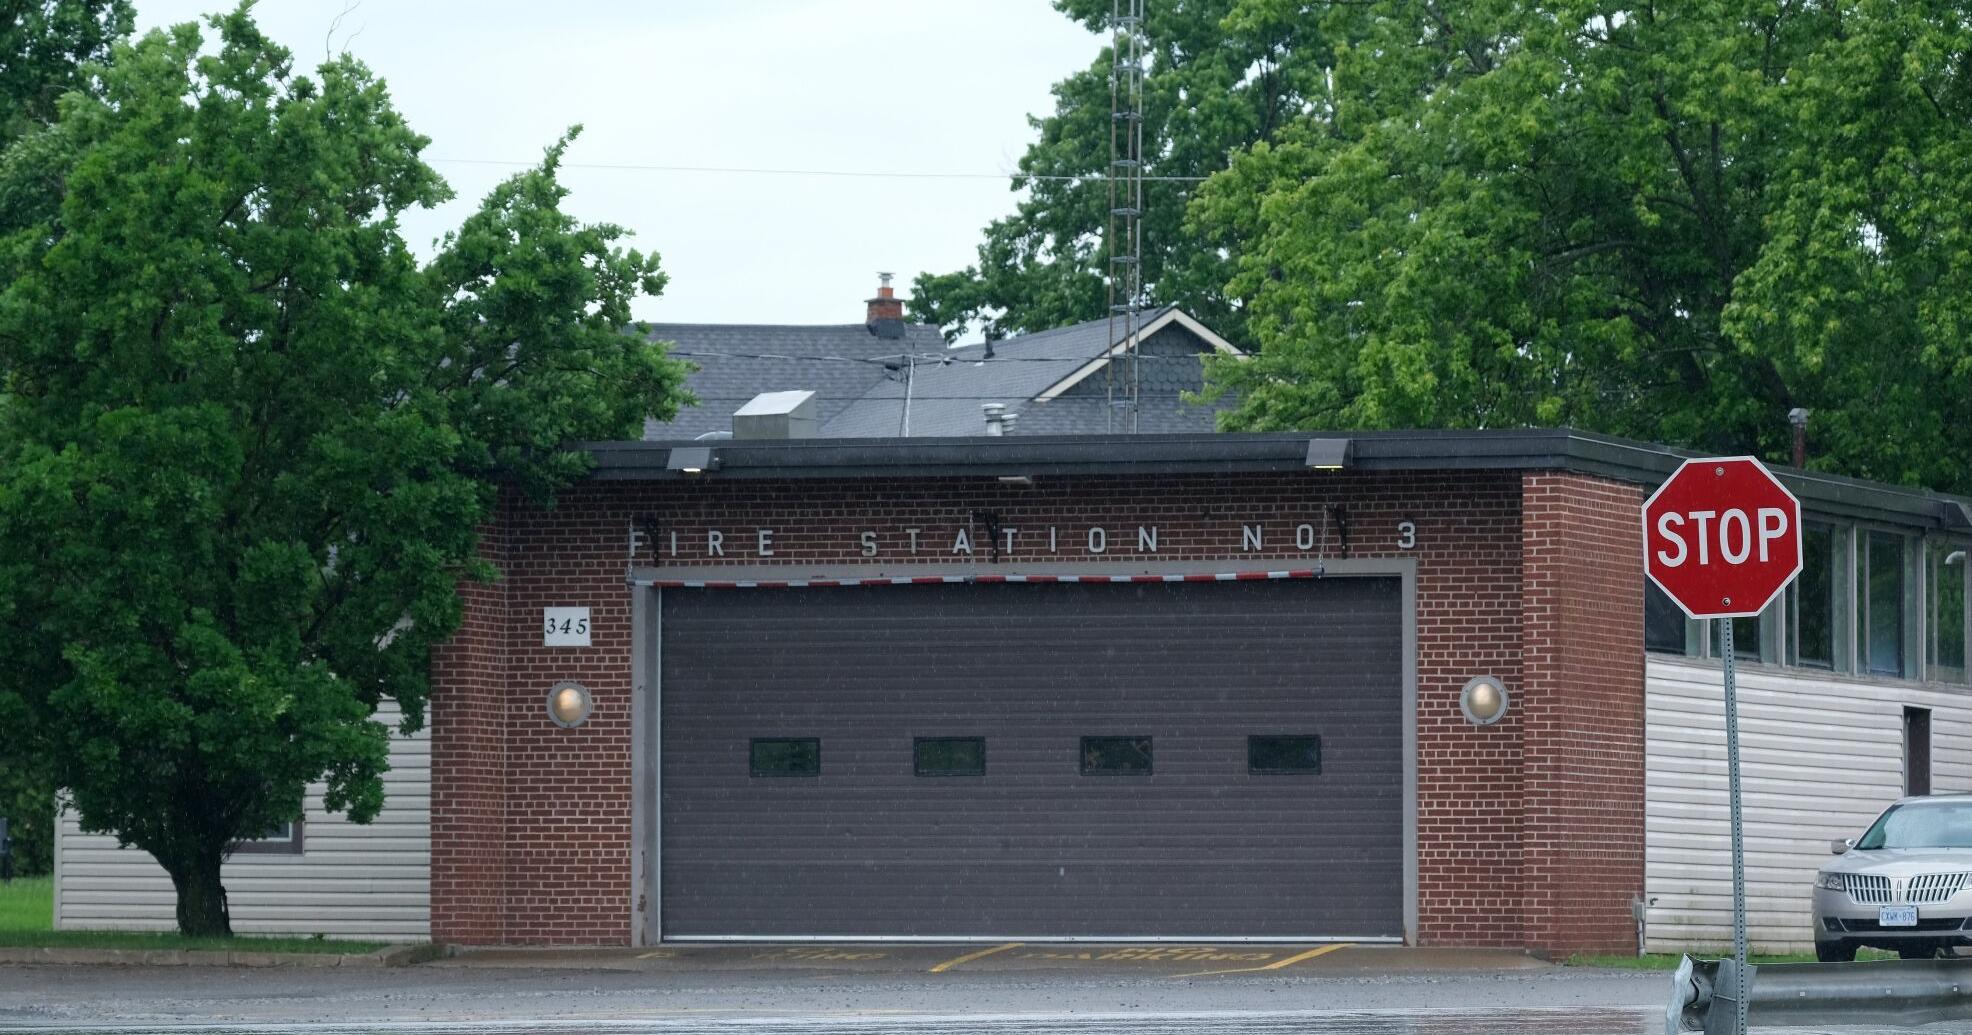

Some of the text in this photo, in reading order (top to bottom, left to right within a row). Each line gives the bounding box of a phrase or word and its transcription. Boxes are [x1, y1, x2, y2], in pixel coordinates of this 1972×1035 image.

[630, 521, 1416, 557] FIRE STATION NO 3
[1657, 507, 1788, 568] STOP
[546, 617, 588, 635] 345
